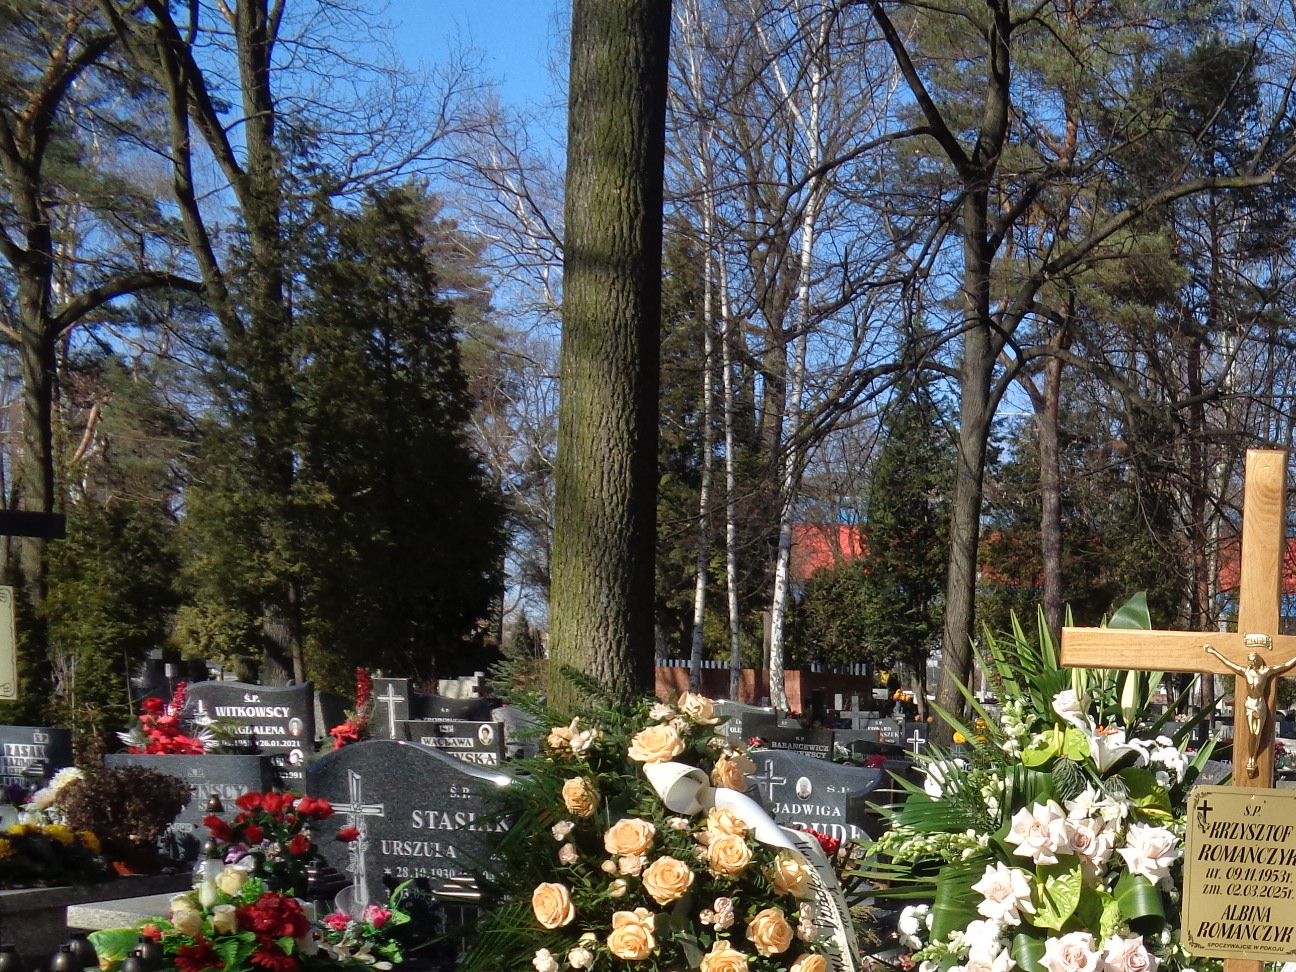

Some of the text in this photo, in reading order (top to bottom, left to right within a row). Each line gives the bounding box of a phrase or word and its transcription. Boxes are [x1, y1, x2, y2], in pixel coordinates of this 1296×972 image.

[215, 706, 290, 718] WITKOWSCY
[772, 802, 842, 817] JADWIGA
[1209, 821, 1294, 843] KRZYSZTOF
[381, 840, 457, 859] URSZULA
[1205, 867, 1293, 884] ur. 09.11.1953r.
[1202, 883, 1295, 900] zm. 02.03.2025r.
[1221, 904, 1271, 922] ALBINA
[1197, 921, 1294, 943] ROMAŃCZYK
